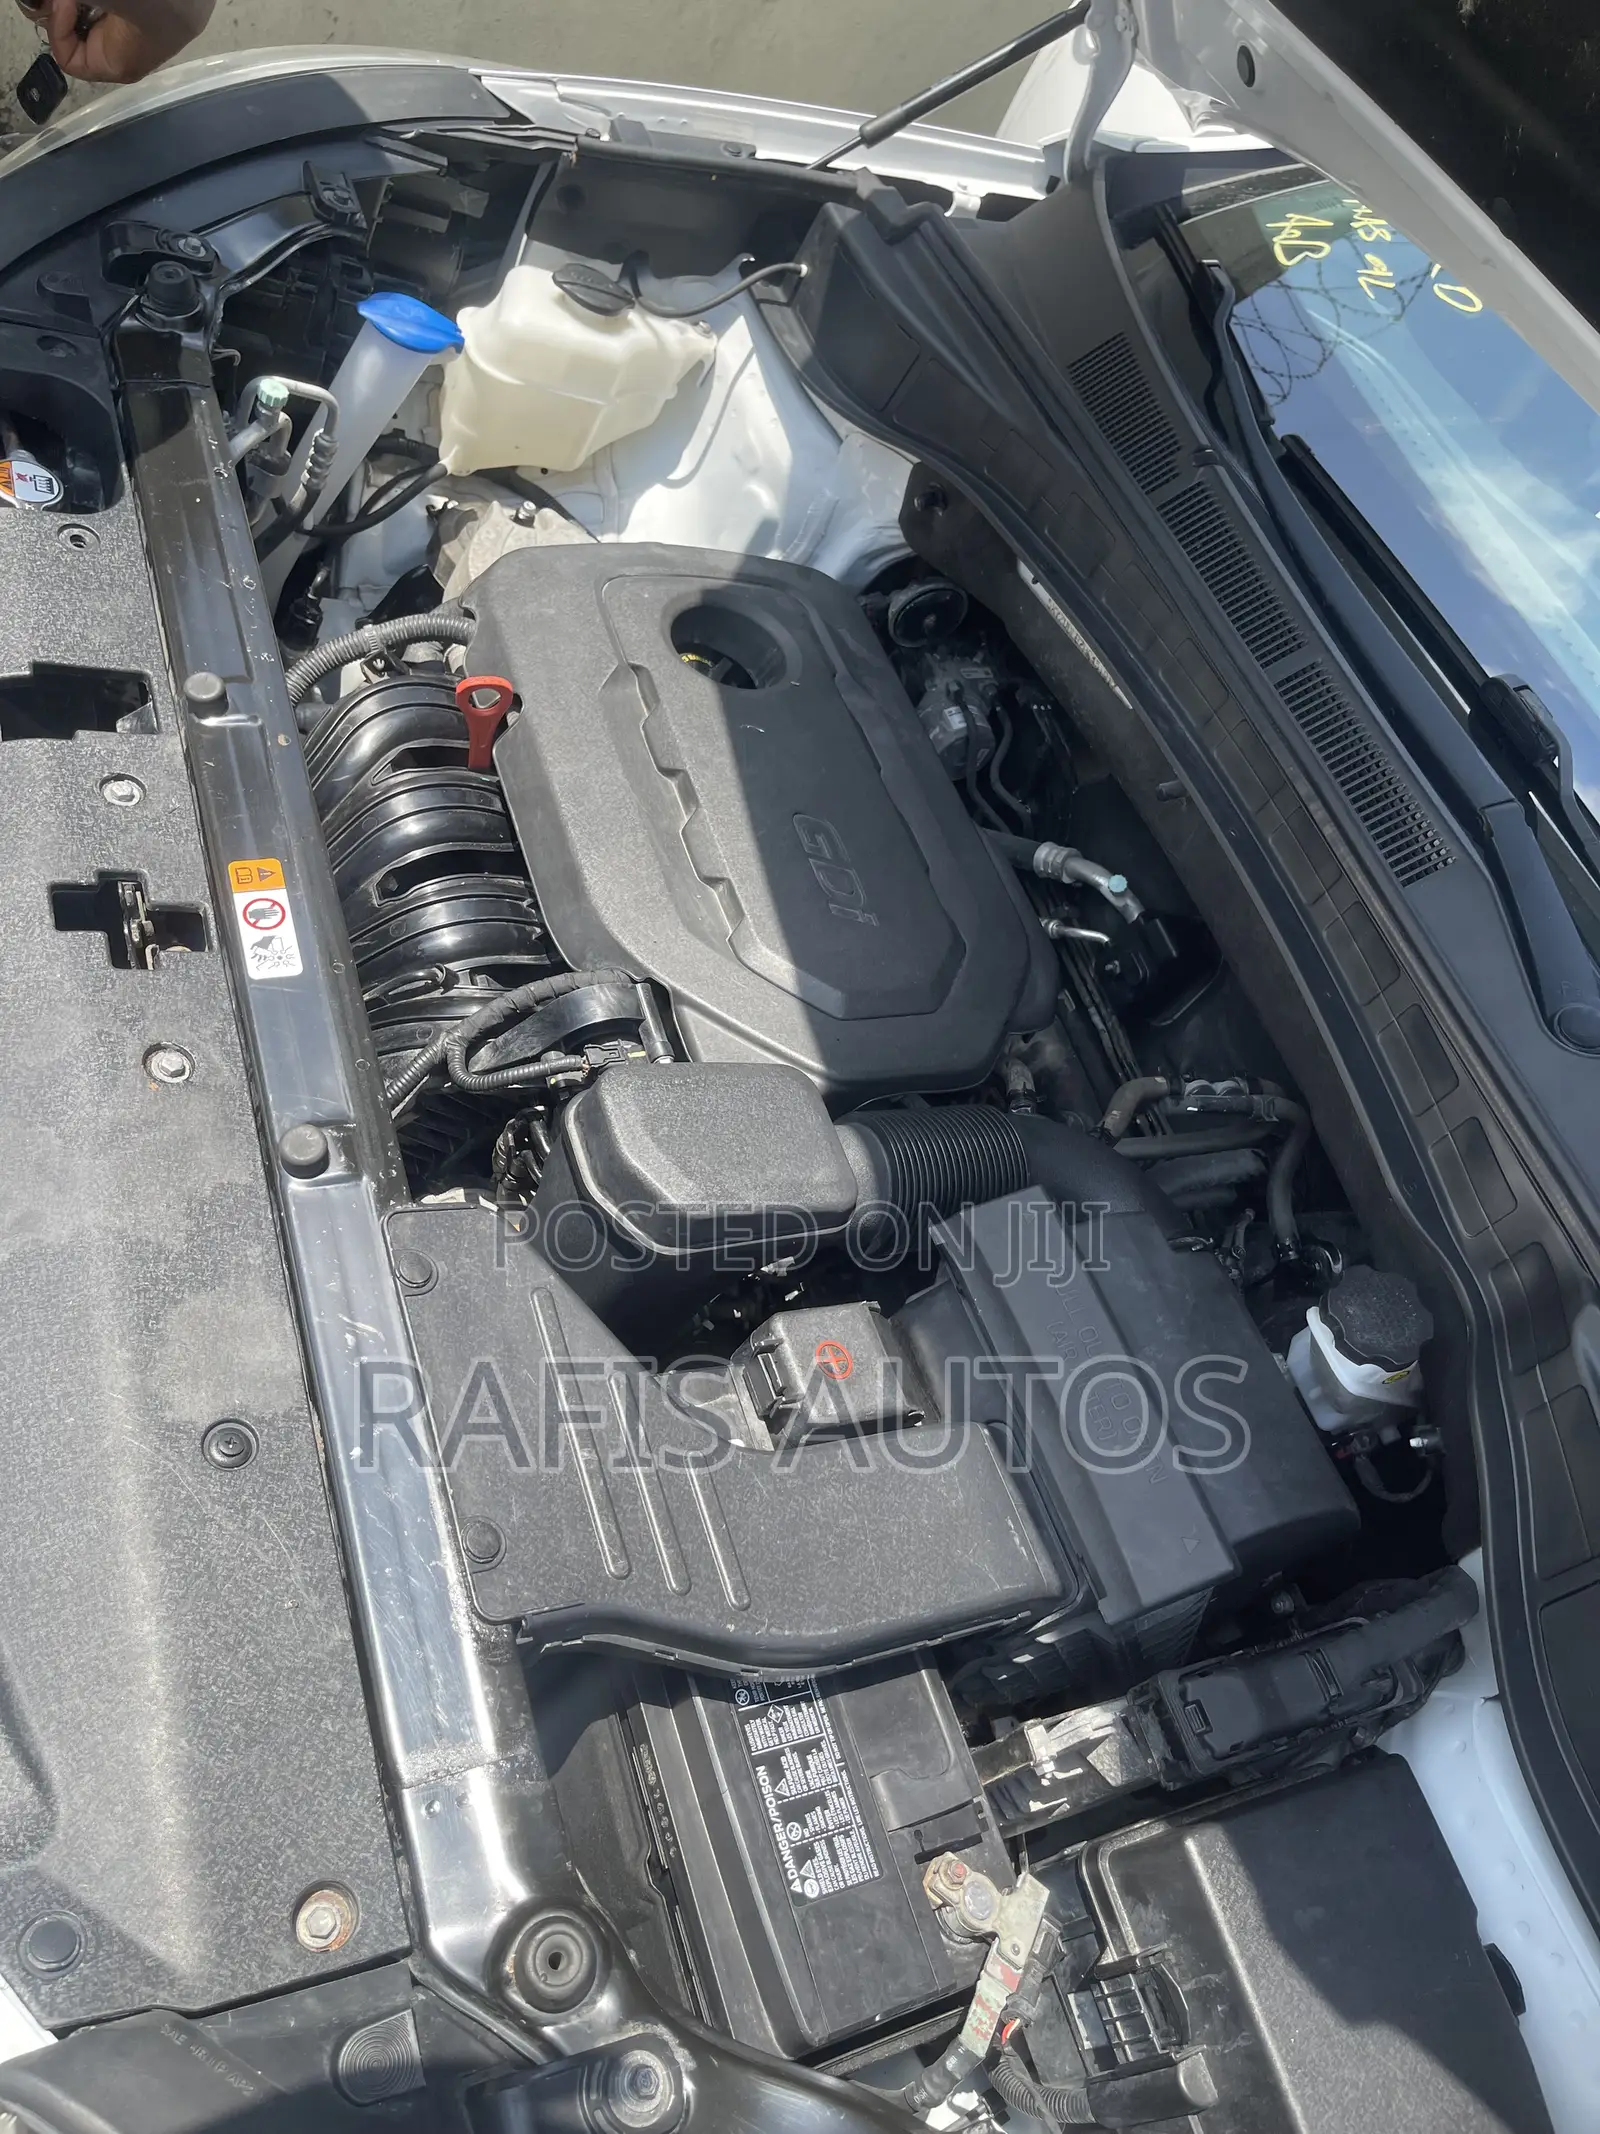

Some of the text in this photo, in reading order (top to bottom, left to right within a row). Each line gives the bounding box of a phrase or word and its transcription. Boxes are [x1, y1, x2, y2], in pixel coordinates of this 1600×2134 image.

[1103, 1378, 1132, 1411] TO
[780, 1756, 789, 1769] ACID
[755, 1765, 799, 1880] DANGER/POISON
[803, 1828, 810, 1838] NO
[813, 1841, 834, 1893] EXPLOSIVE GASES
[817, 1873, 828, 1894] SHIELD
